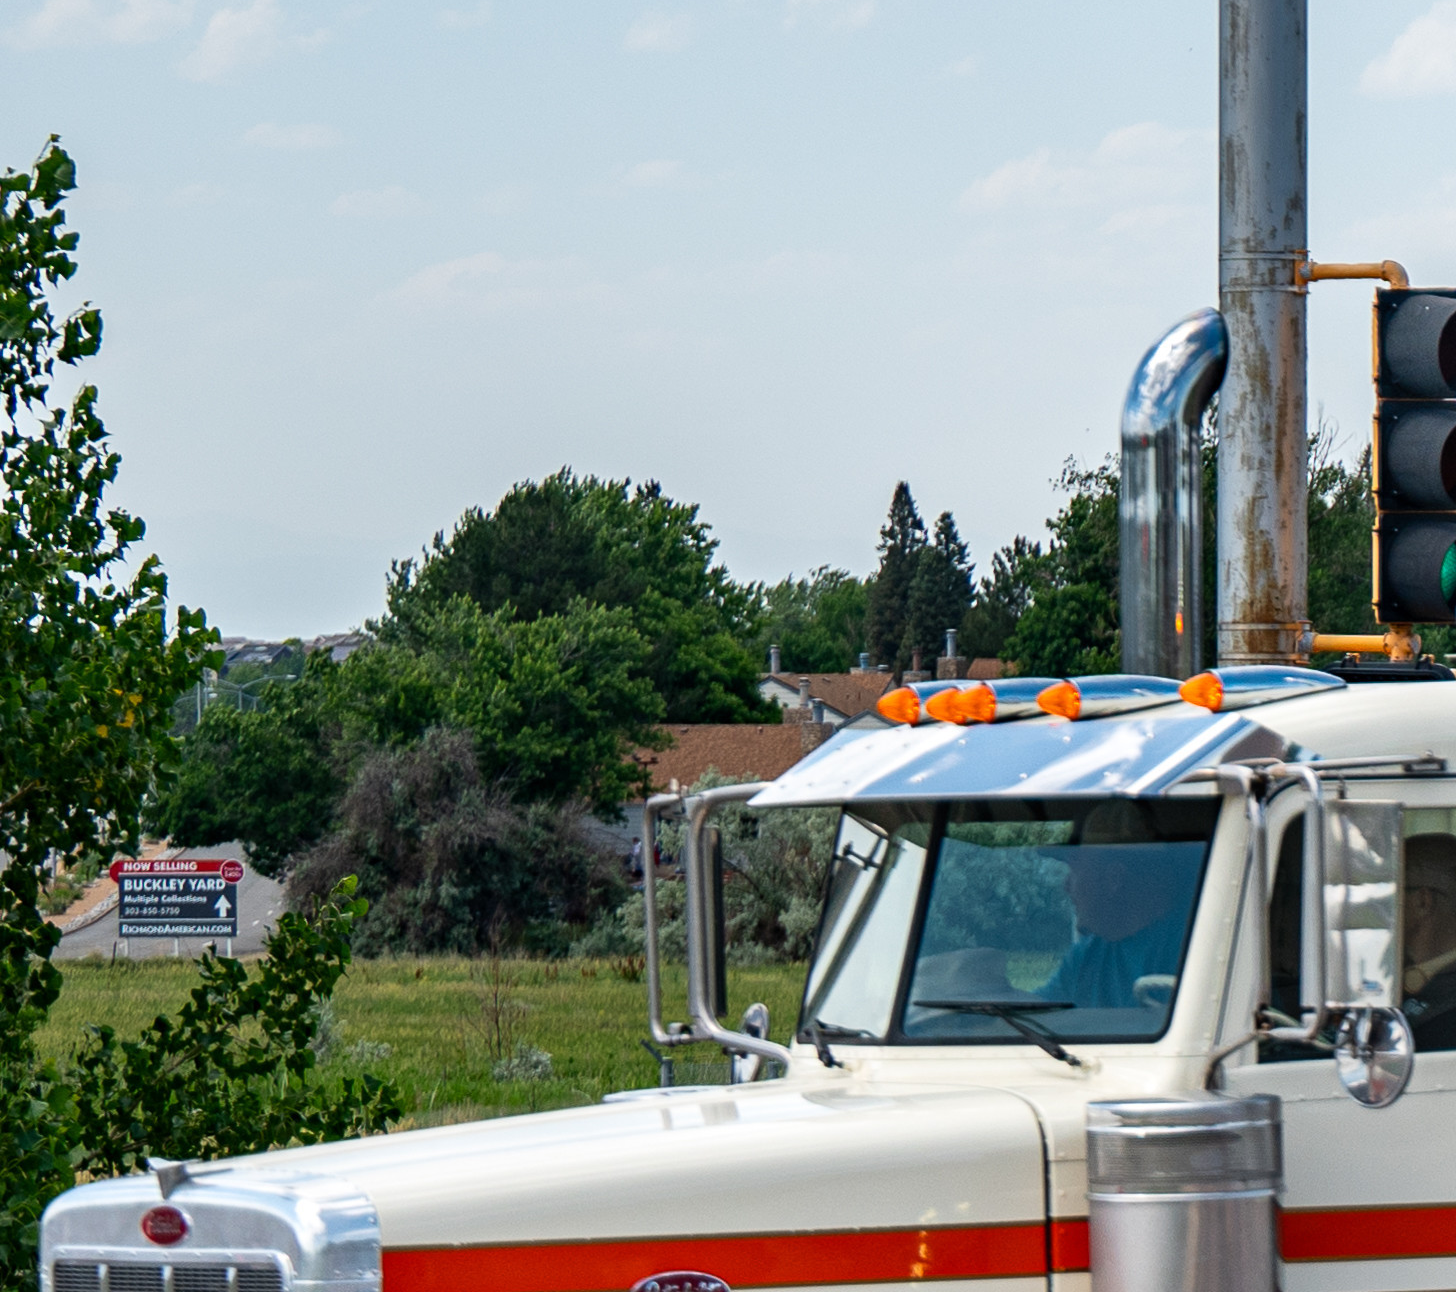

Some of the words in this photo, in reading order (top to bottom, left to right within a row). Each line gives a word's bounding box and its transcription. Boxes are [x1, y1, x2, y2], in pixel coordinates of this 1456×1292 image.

[123, 862, 151, 871] NOW
[154, 861, 198, 871] SELLING
[123, 879, 185, 891] BUCKLEY
[188, 878, 226, 890] YARD
[124, 895, 159, 904] Multiple
[161, 894, 207, 903] Collections
